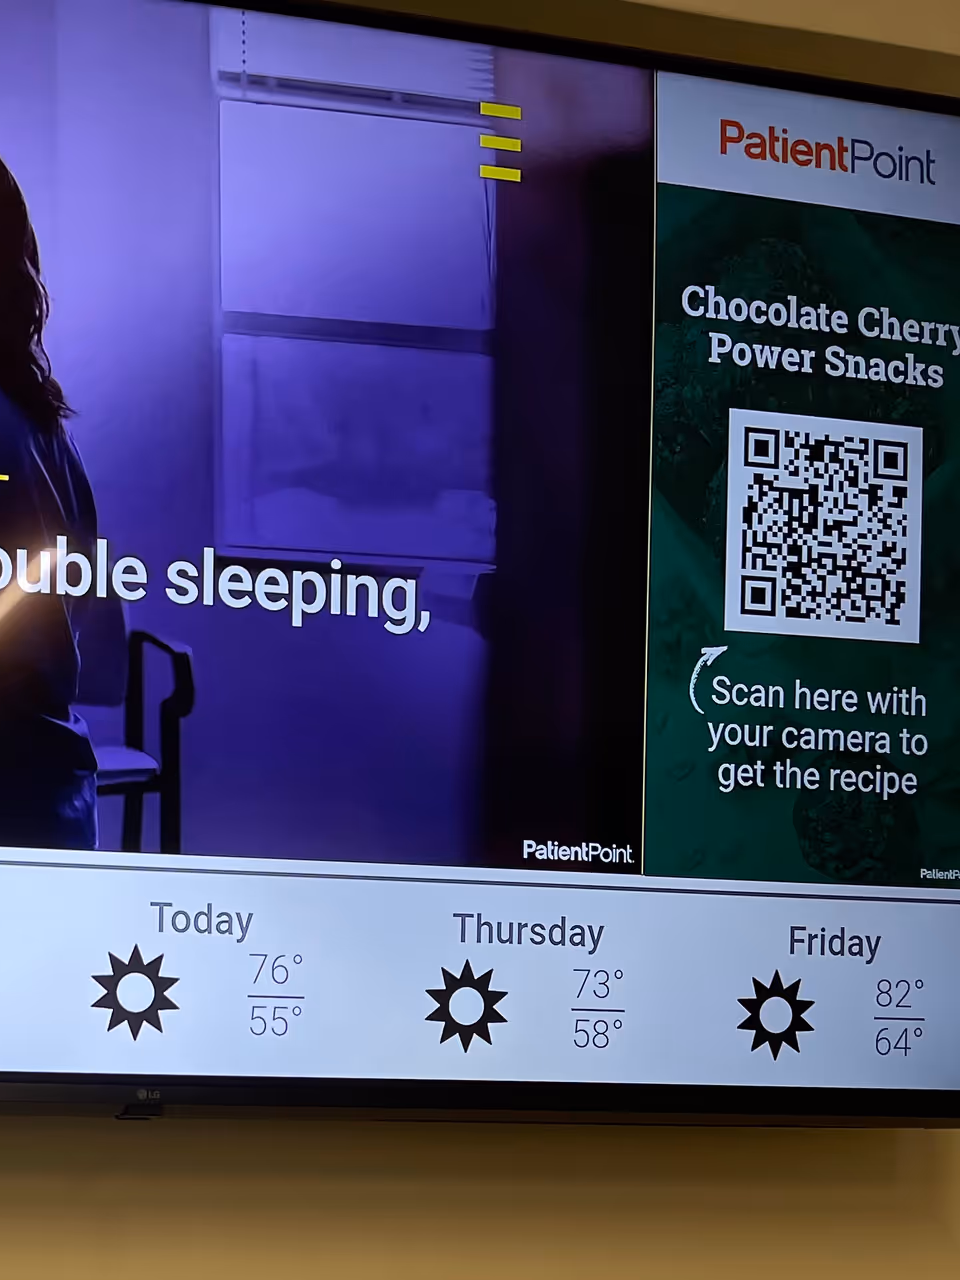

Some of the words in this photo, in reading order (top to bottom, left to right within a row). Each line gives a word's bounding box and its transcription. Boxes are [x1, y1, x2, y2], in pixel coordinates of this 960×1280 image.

[719, 117, 937, 186] PatientPoint
[681, 284, 849, 334] Chocolate
[857, 306, 960, 356] Cherry
[707, 331, 816, 374] Power
[824, 345, 945, 389] Snacks
[165, 546, 431, 635] sleeping,
[711, 675, 785, 709] Scan
[794, 679, 858, 713] here
[866, 686, 927, 717] with
[707, 721, 774, 752] your
[780, 725, 891, 754] camera
[899, 728, 929, 756] to
[717, 760, 765, 793] get
[772, 758, 821, 790] the
[828, 764, 918, 801] recipe
[149, 901, 254, 944] Today
[452, 911, 605, 955] Thursday
[788, 925, 882, 965] Friday
[248, 953, 303, 986] 76°
[572, 968, 624, 1000] 73°
[875, 978, 925, 1009] 82°
[248, 1005, 303, 1037] 55°
[572, 1019, 623, 1049] 58°
[874, 1026, 924, 1057] 64°
